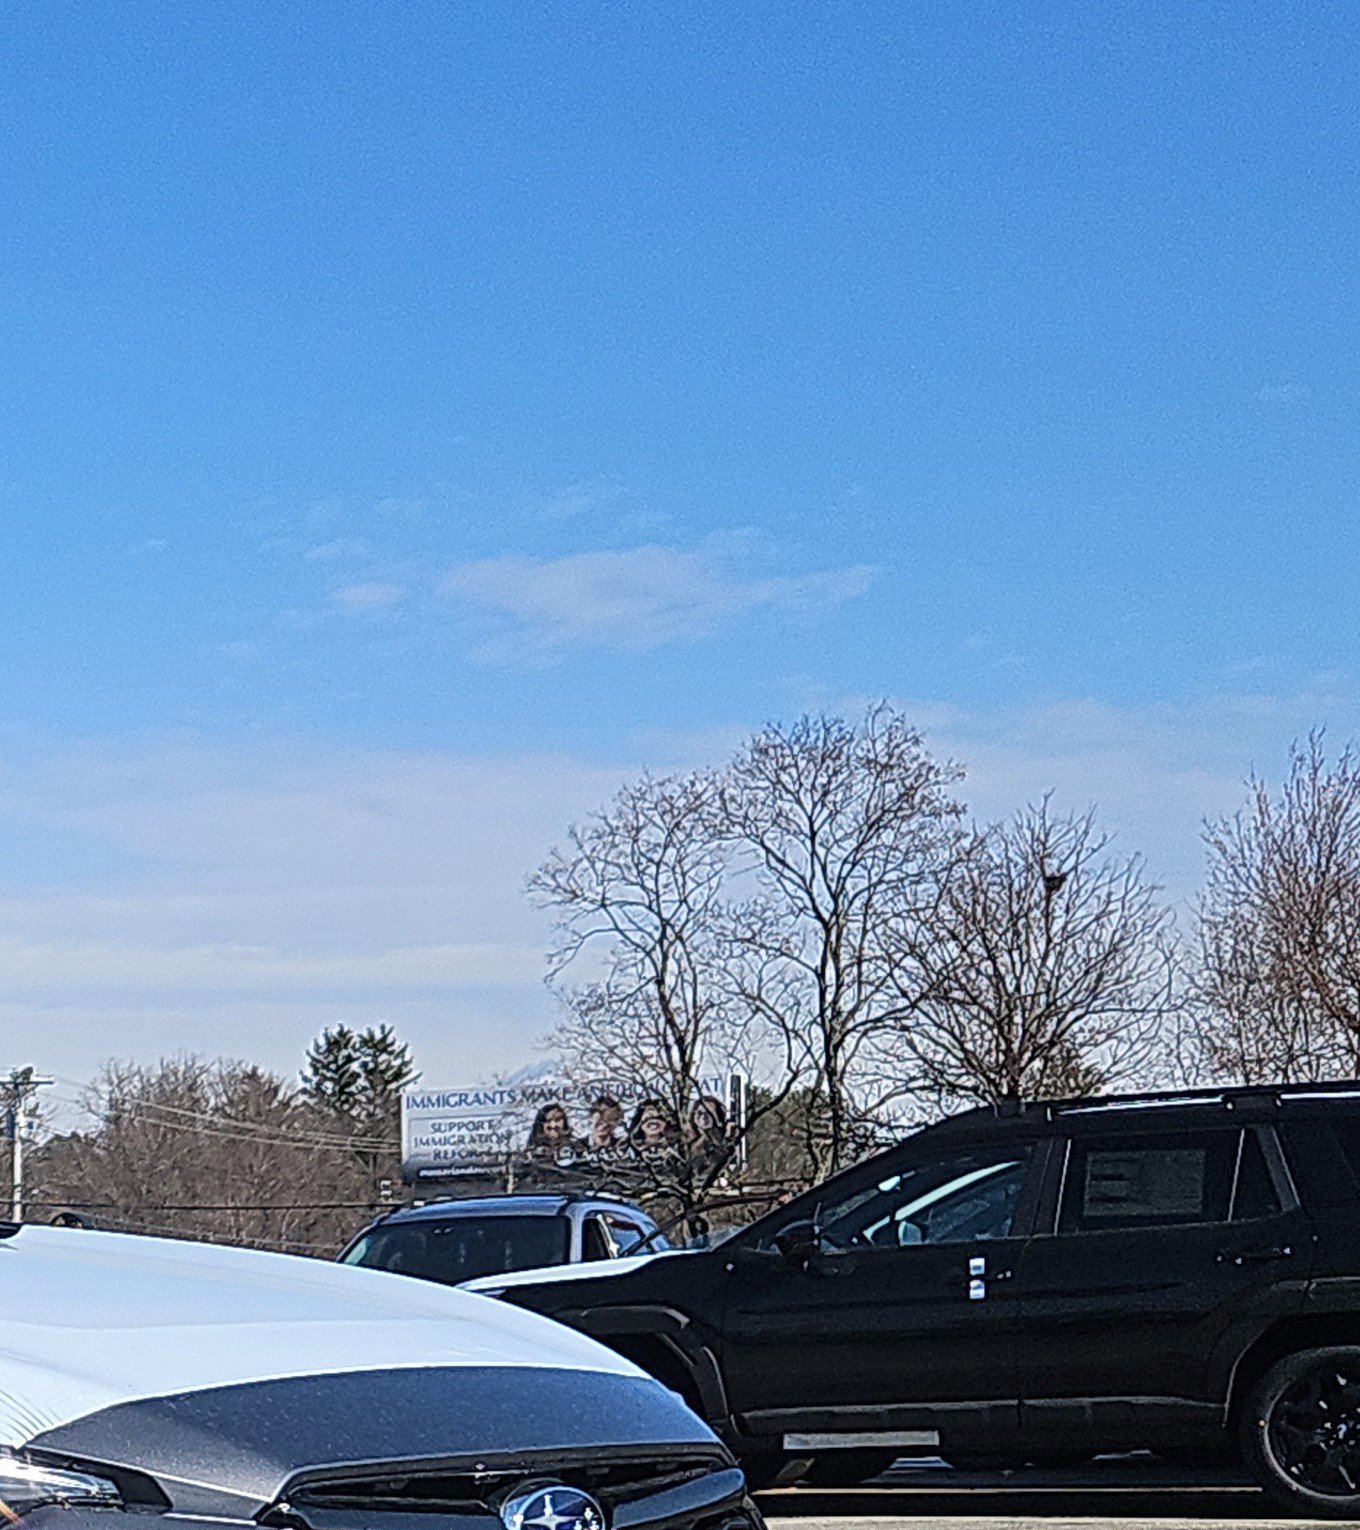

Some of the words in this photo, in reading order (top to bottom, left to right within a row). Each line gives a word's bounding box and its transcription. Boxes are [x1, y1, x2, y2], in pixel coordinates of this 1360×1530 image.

[406, 1089, 517, 1109] IMMIGRANTS
[431, 1120, 493, 1133] SUPPORT
[433, 1149, 493, 1160] REFOR
